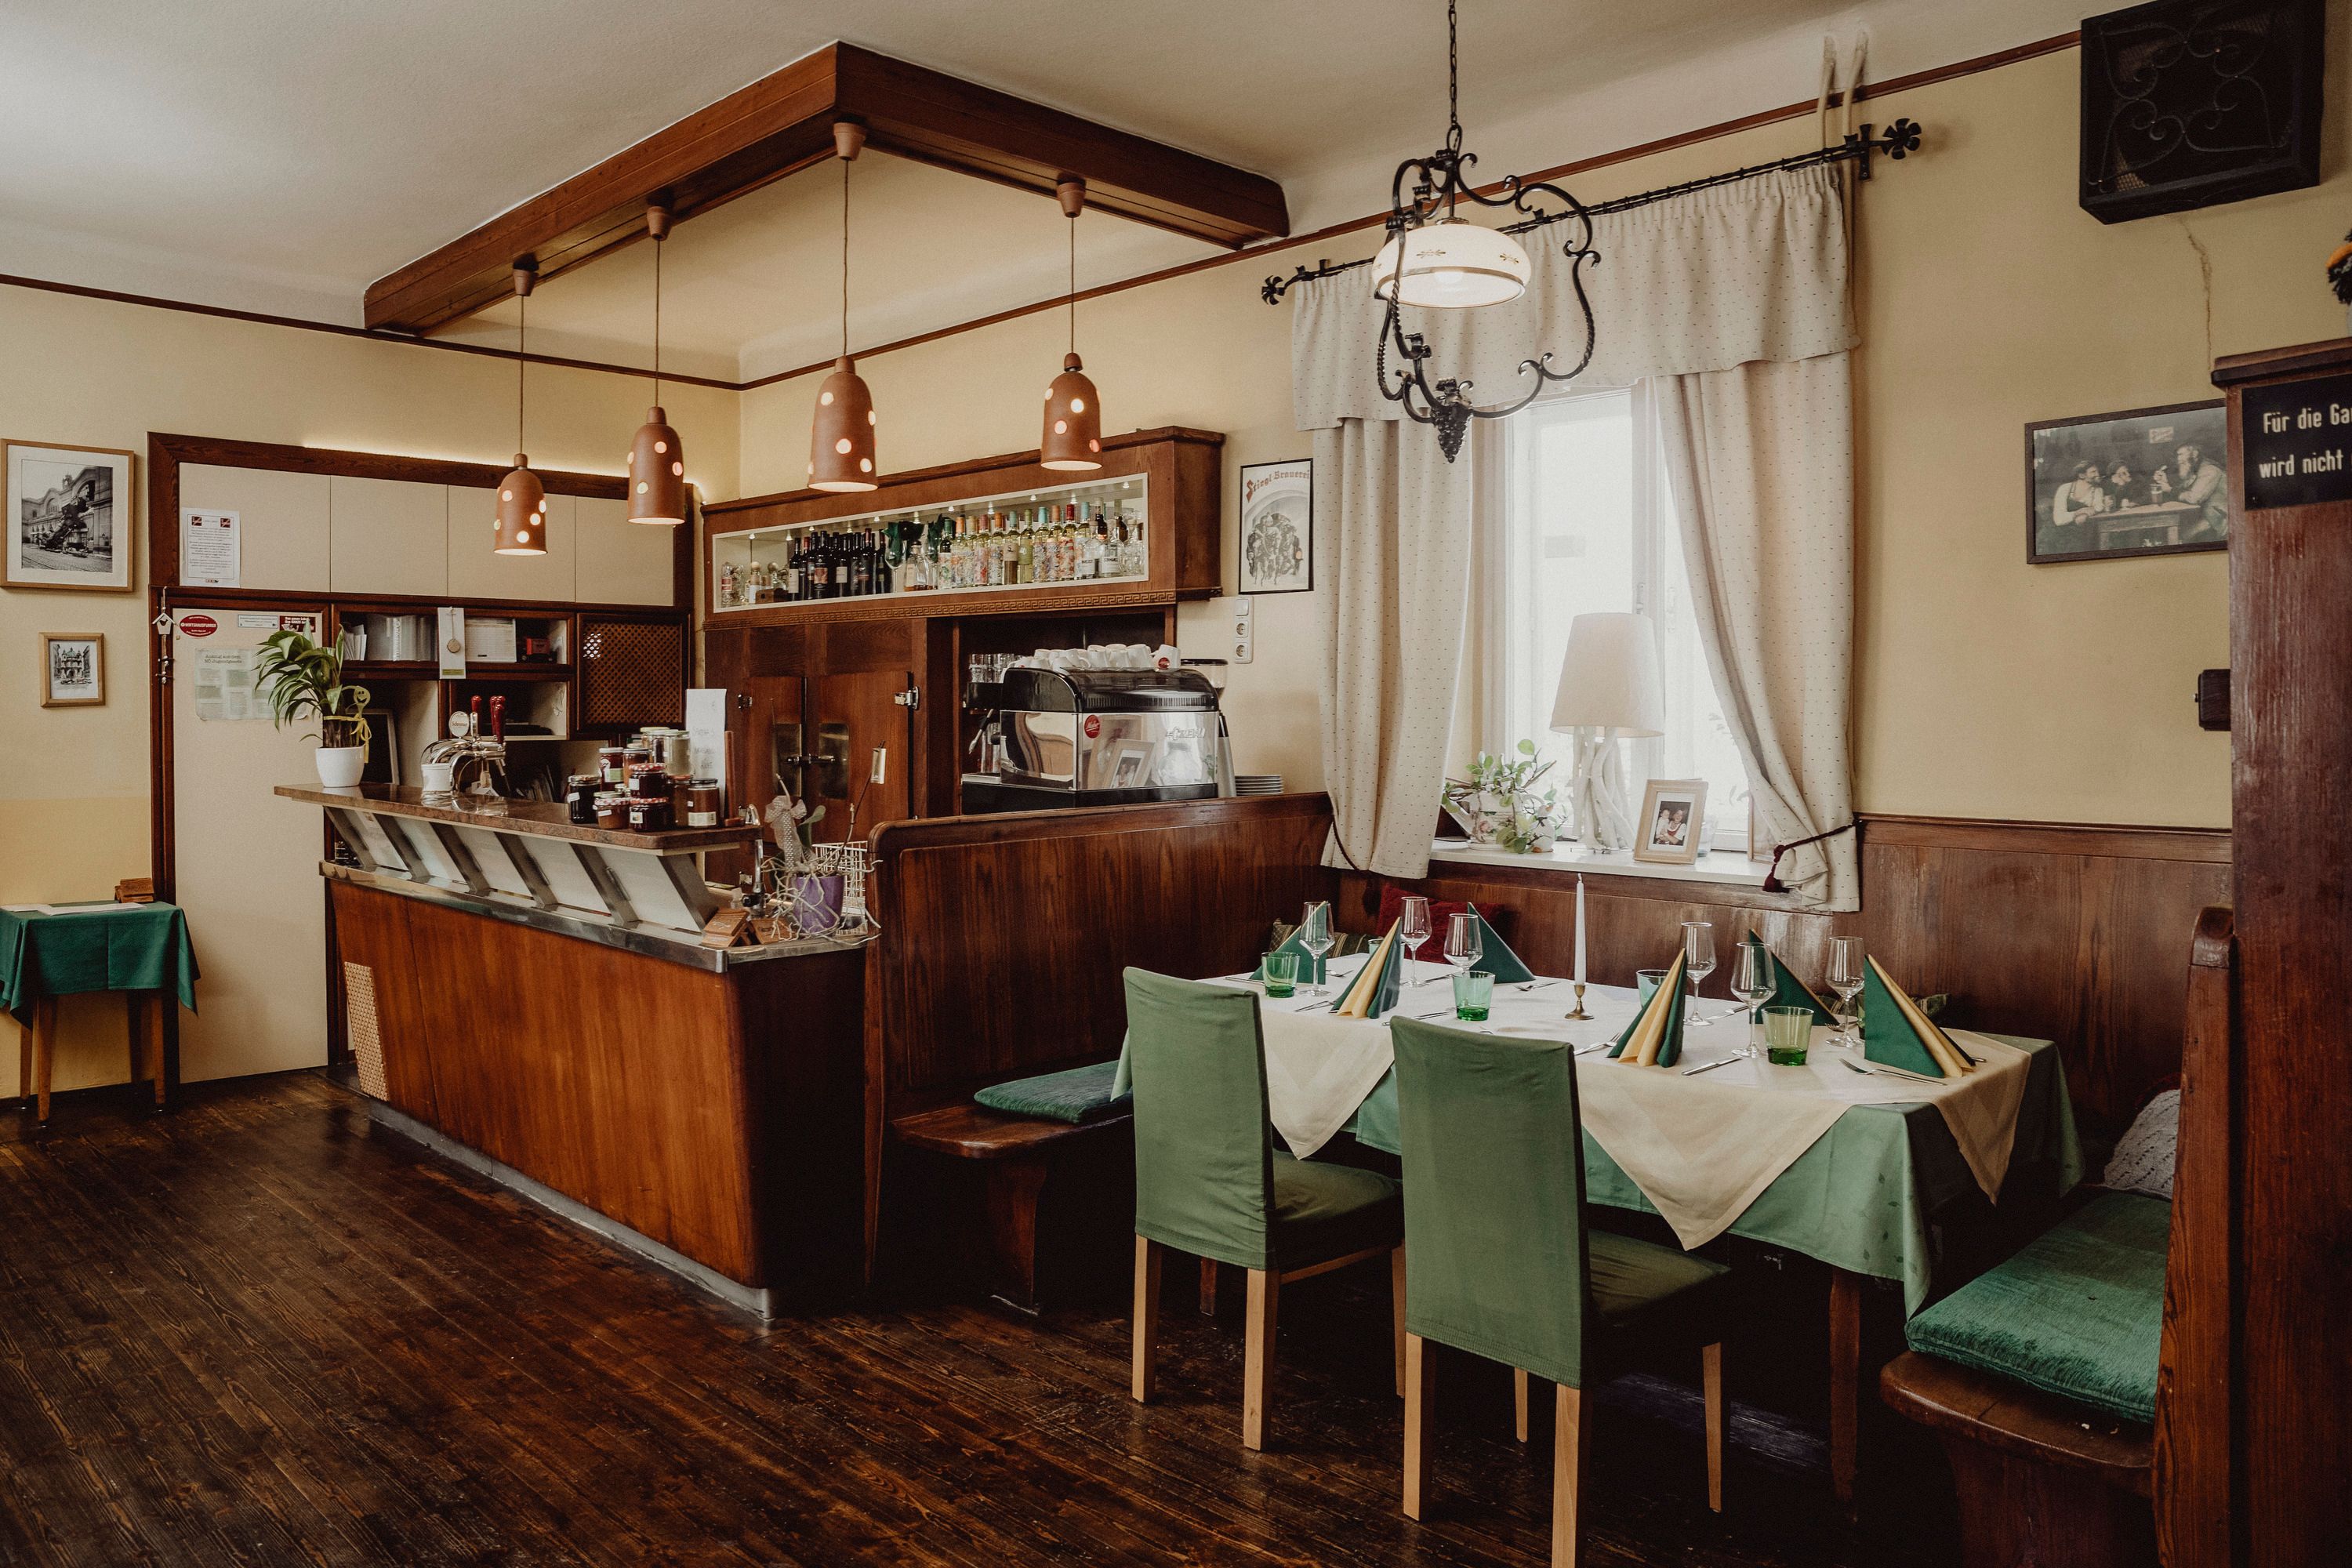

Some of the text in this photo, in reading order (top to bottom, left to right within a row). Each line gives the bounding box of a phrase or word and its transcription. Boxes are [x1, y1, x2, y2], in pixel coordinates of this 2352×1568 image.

[2263, 403, 2352, 434] Für die Ga
[2259, 454, 2295, 478] wird
[2302, 448, 2344, 474] nicht
